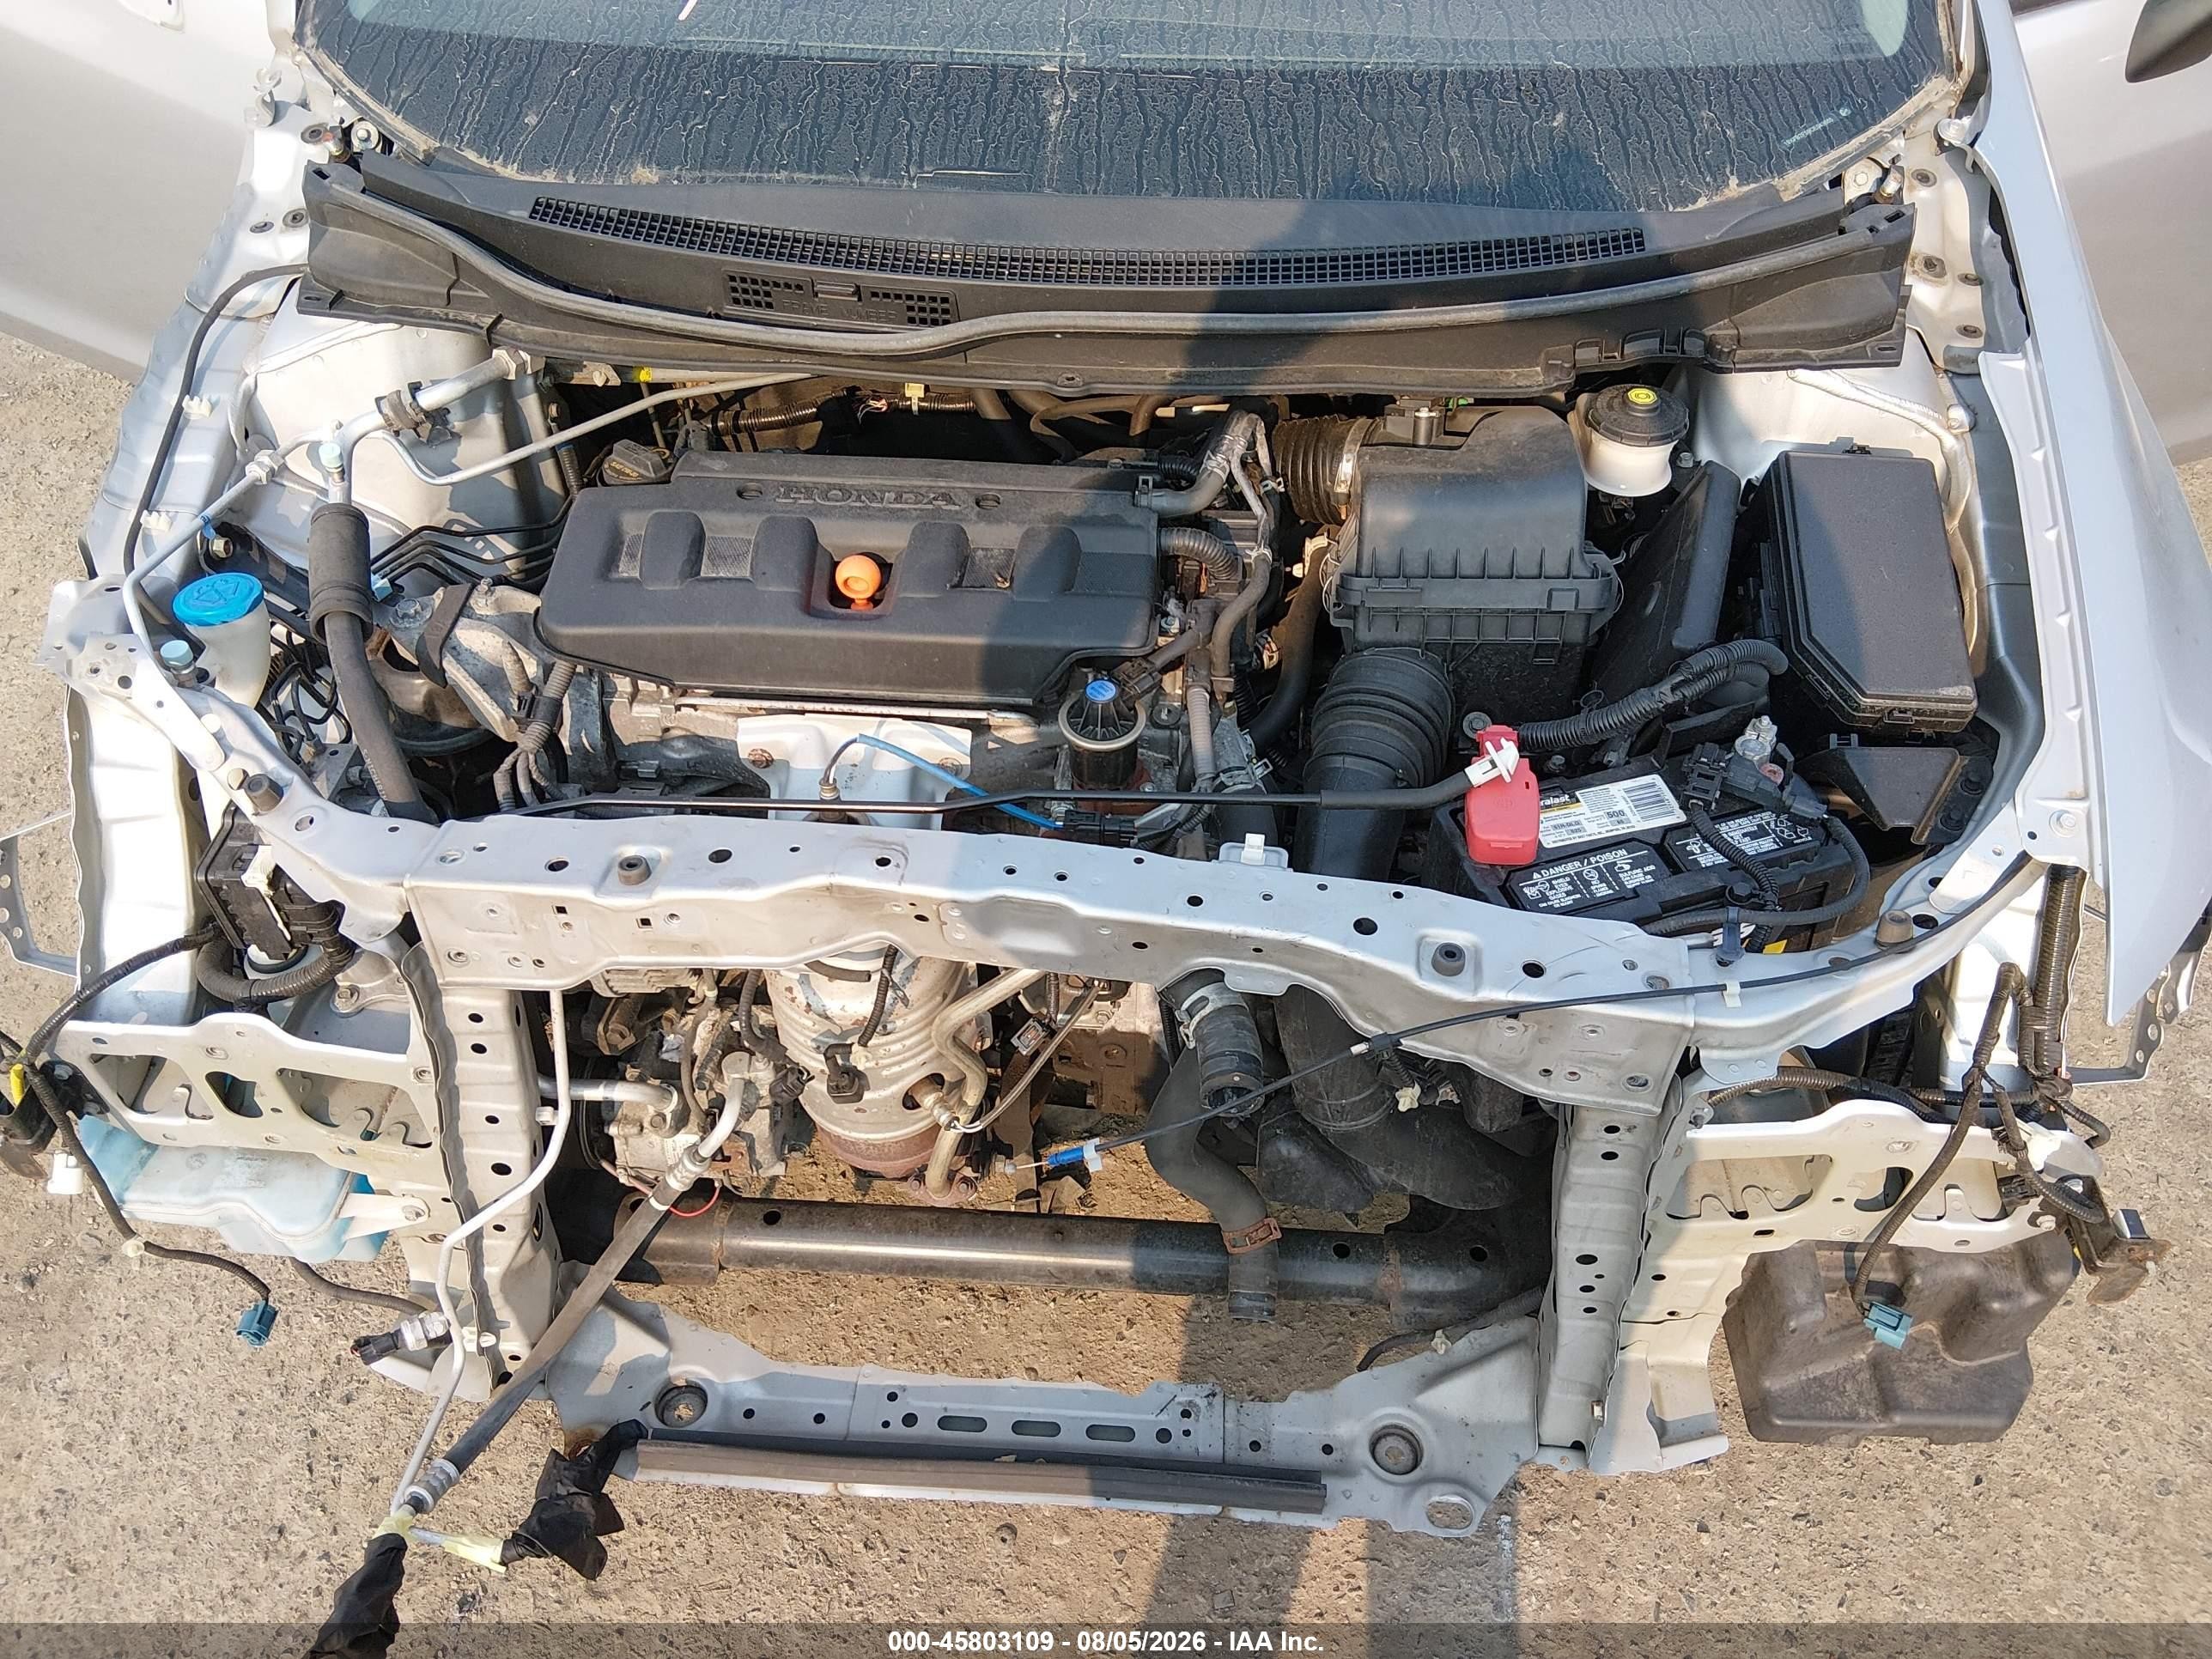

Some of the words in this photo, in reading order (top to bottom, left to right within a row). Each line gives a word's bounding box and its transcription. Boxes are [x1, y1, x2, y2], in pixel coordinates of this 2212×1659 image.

[782, 300, 829, 316] FRAME
[840, 307, 898, 322] NUMBER
[776, 486, 962, 510] HONDA
[1540, 794, 1570, 806] ralast
[1607, 809, 1625, 818] 500
[1540, 860, 1582, 877] DANGER
[1589, 848, 1627, 864] POISON
